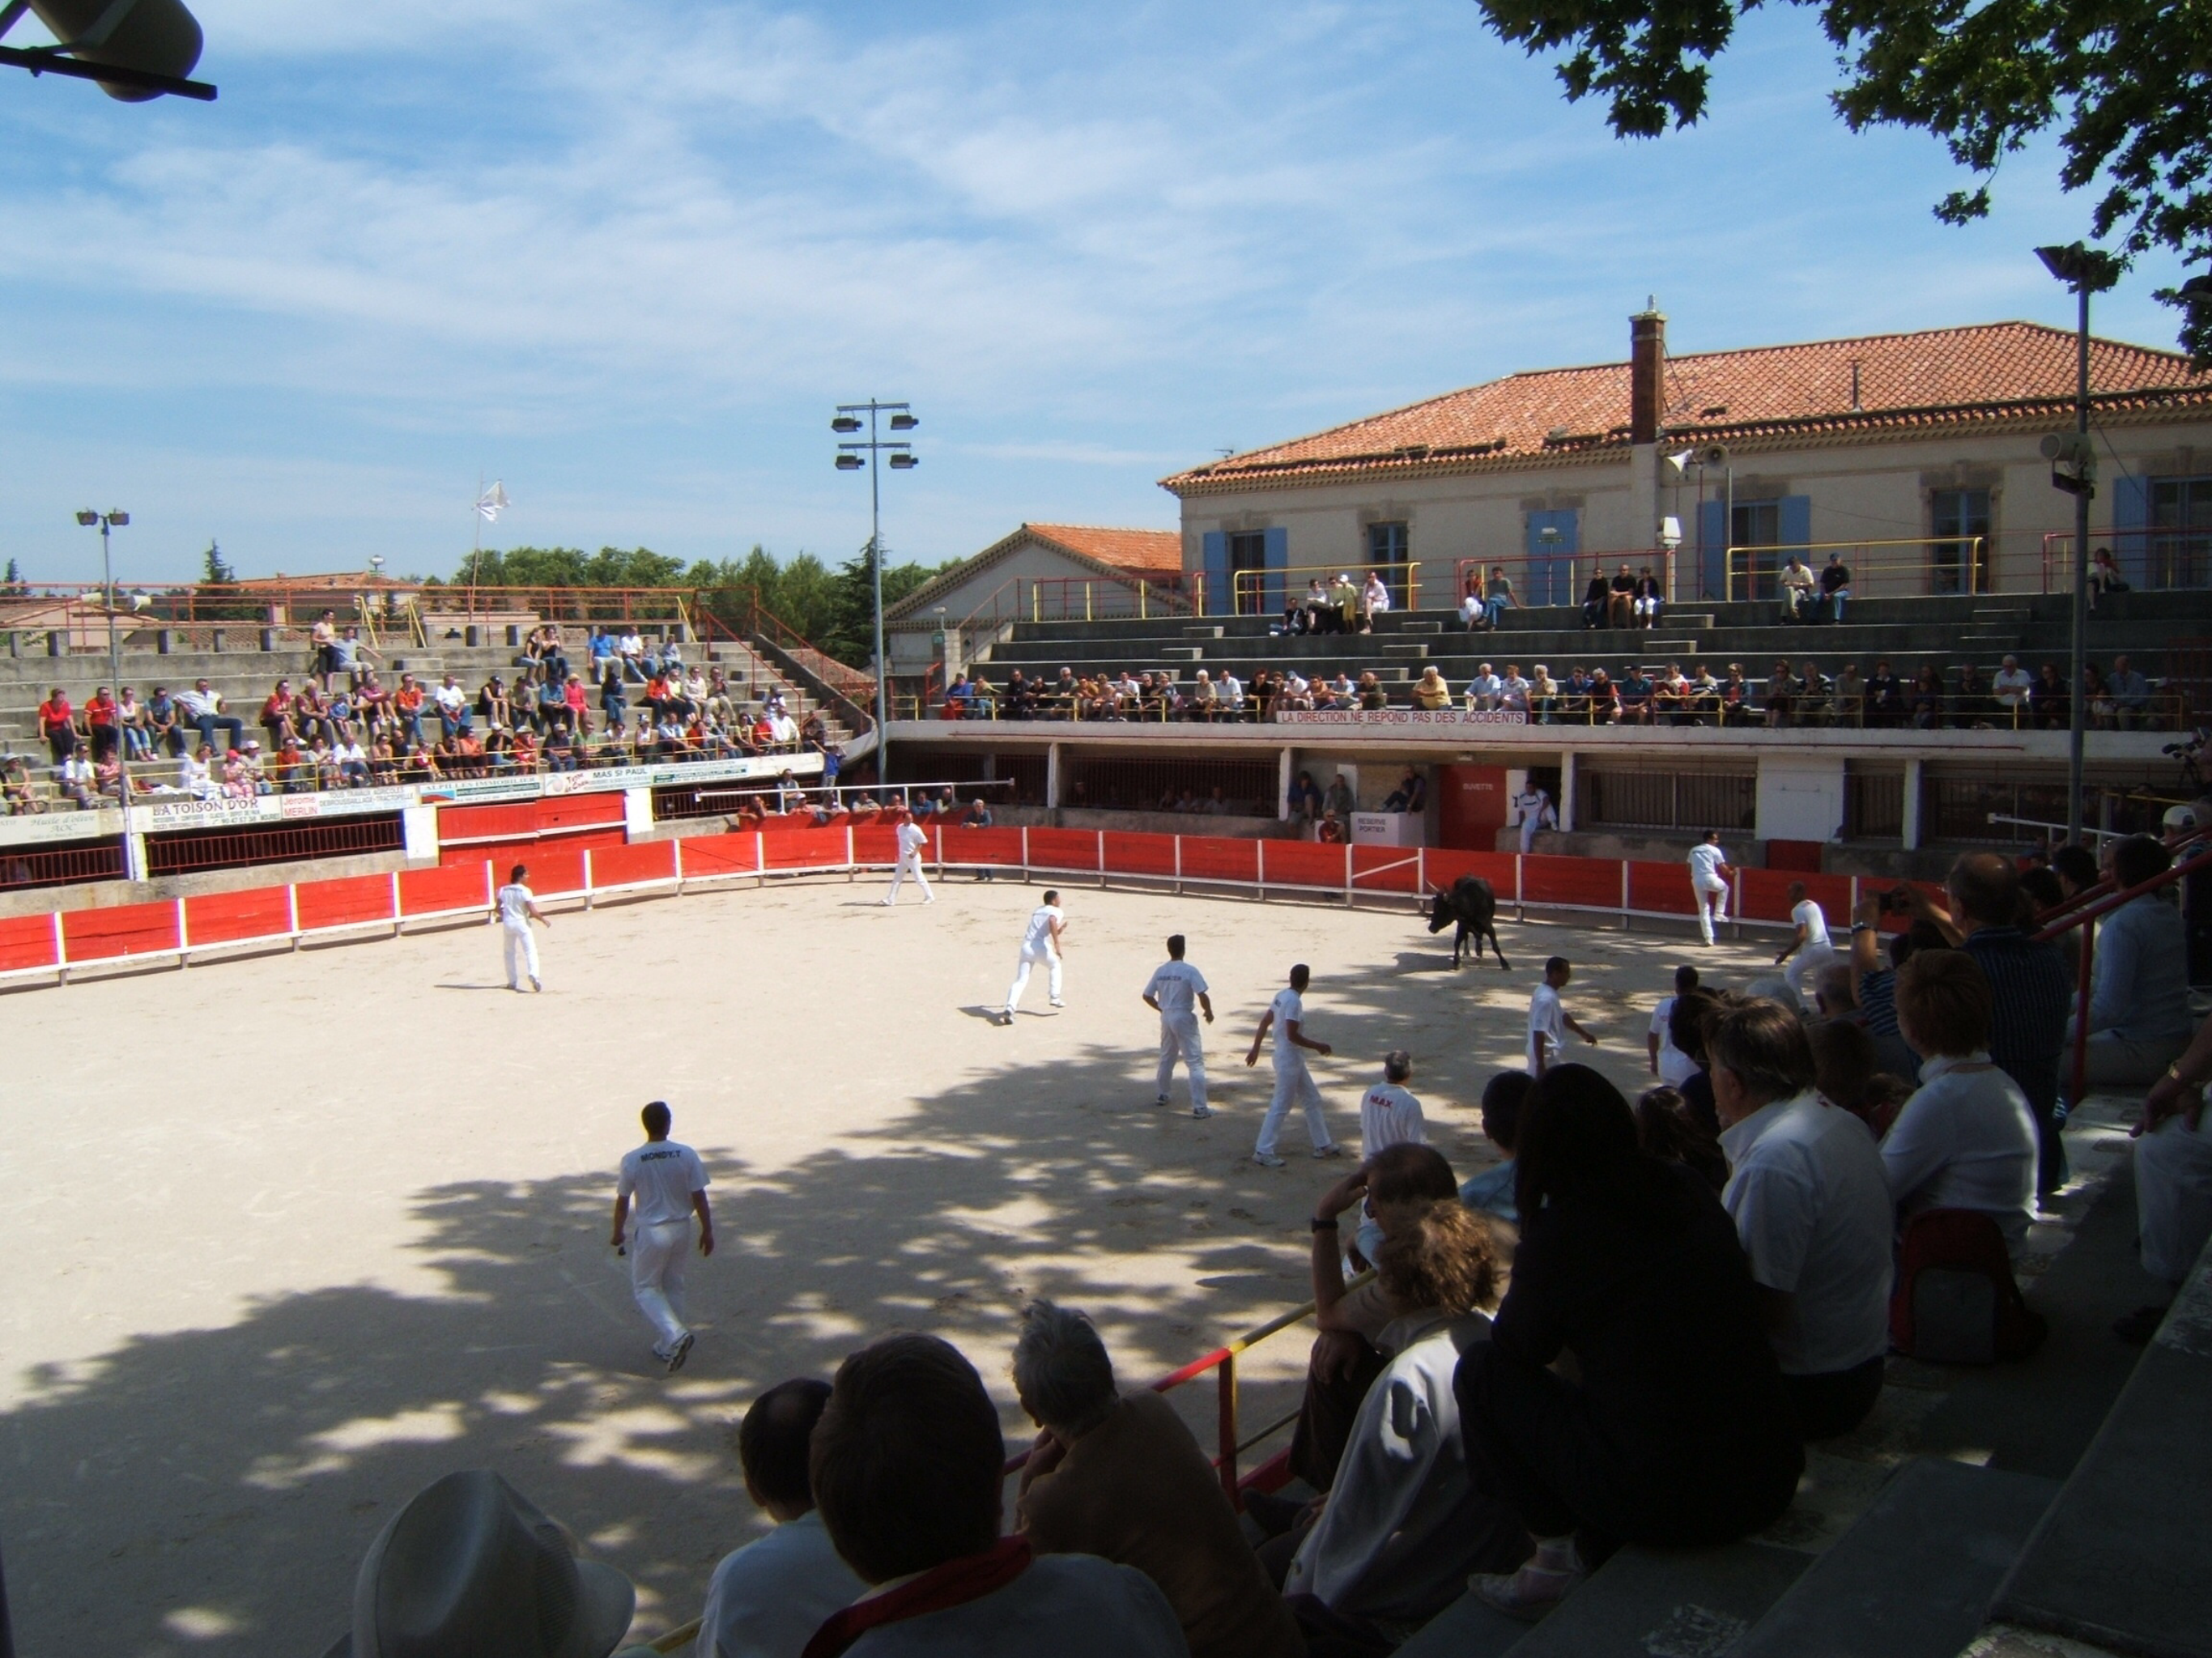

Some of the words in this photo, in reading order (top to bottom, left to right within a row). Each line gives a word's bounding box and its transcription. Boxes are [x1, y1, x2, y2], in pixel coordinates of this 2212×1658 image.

[1282, 712, 1294, 722] LA
[1297, 712, 1346, 722] DIRECTION
[1351, 712, 1363, 722] NE
[1368, 712, 1409, 722] REPOND
[1412, 712, 1431, 722] PAS
[1436, 712, 1457, 723] DES
[1462, 712, 1523, 724] ACCIDENTS
[625, 767, 648, 776] PAUL
[173, 800, 223, 814] TOISON
[228, 797, 258, 810] D'OR
[283, 807, 318, 817] MERLIN
[1370, 1095, 1393, 1108] MAX
